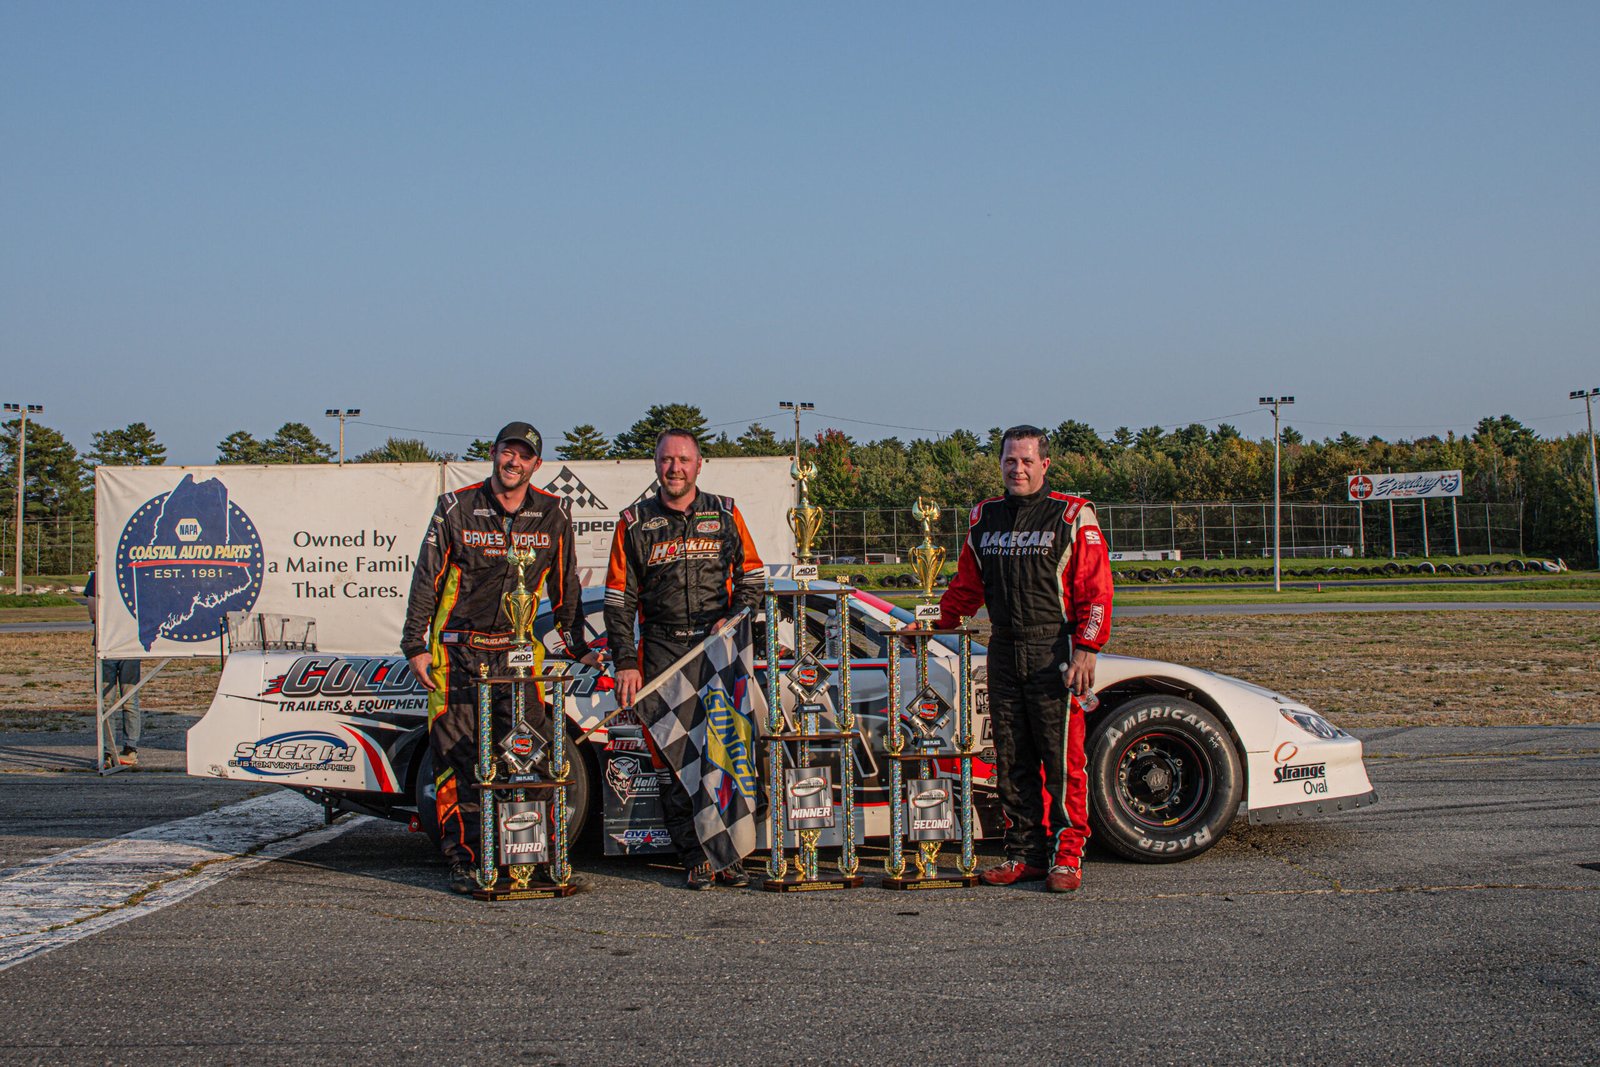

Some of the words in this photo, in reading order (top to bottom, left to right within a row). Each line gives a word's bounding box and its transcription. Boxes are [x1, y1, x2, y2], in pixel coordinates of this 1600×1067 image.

[180, 524, 198, 535] NAPA
[293, 530, 366, 548] Owned
[373, 530, 397, 552] by
[980, 530, 1055, 547] RACECAR
[128, 545, 177, 560] COASTAL
[178, 545, 213, 559] AUTO
[213, 544, 253, 559] PARTS
[982, 547, 1049, 556] ENGINEERING
[268, 561, 279, 573] a
[286, 556, 350, 573] Maine
[154, 569, 185, 578] EST.
[191, 568, 223, 578] 1981
[292, 582, 336, 598] That
[343, 582, 403, 598] Cares.
[279, 700, 340, 712] TRAILERS
[341, 700, 351, 712] &
[1105, 706, 1212, 748] AMERICAN
[234, 742, 318, 760] Stick
[319, 745, 357, 762] It!
[228, 760, 271, 769] CUSTOM
[271, 760, 303, 770] VINYL
[303, 762, 355, 772] GRAPHICS
[1274, 763, 1326, 783] Strange
[1303, 779, 1328, 795] Oval
[791, 807, 831, 819] WINNER
[913, 819, 950, 830] SECOND
[1138, 825, 1212, 851] RACER
[505, 842, 542, 854] THIRD
